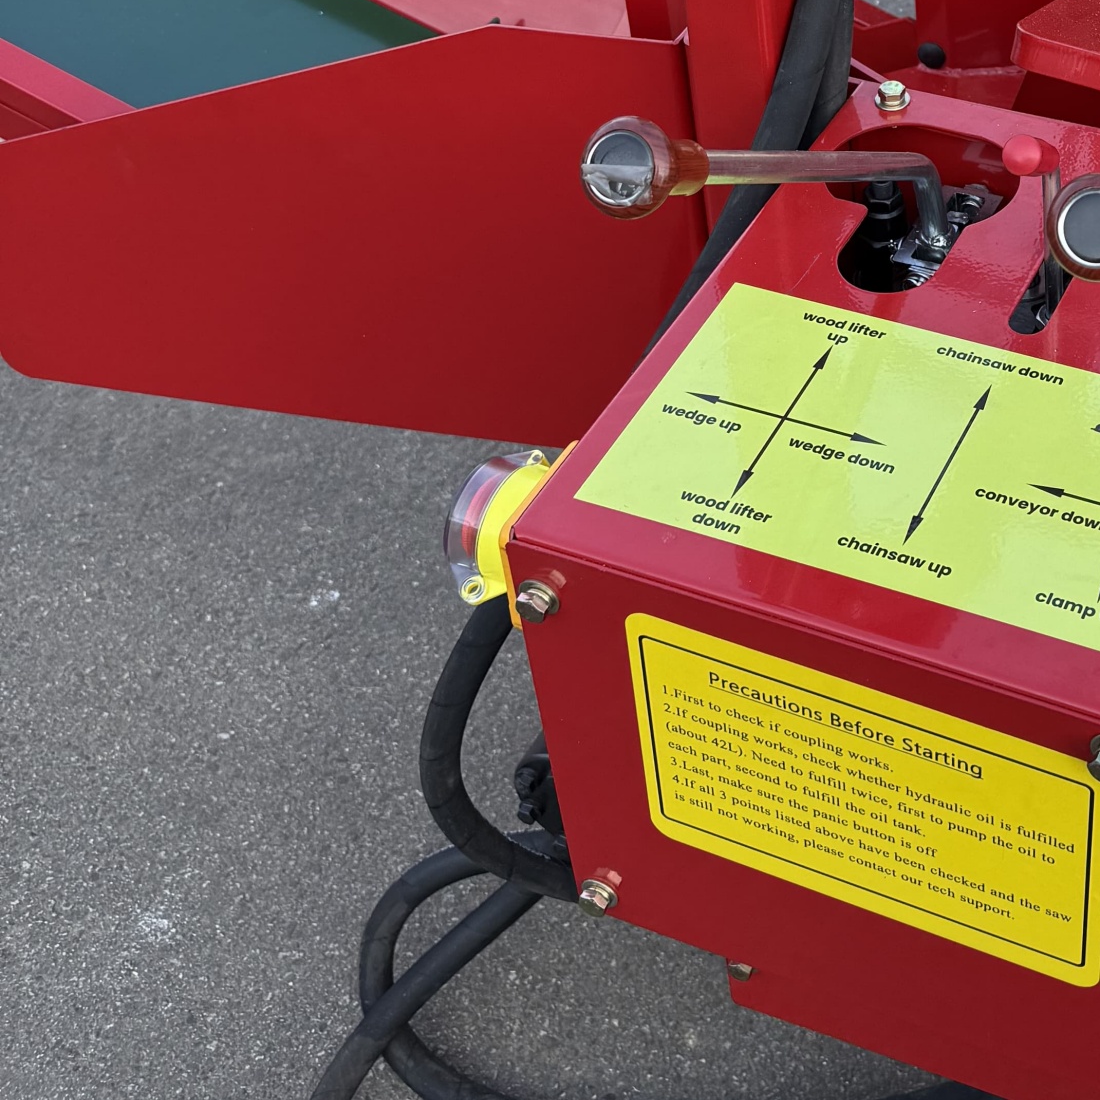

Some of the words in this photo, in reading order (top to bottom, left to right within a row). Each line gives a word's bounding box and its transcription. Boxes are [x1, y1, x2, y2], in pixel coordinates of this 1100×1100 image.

[803, 312, 848, 330] wood
[847, 322, 887, 339] lifter
[827, 332, 849, 345] up
[936, 347, 1017, 373] chainsaw
[1018, 367, 1064, 385] down
[662, 404, 717, 426] wedge
[718, 419, 742, 434] up
[788, 438, 845, 460] wedge
[847, 453, 895, 474] down
[680, 490, 730, 511] wood
[729, 502, 773, 523] lifter
[975, 488, 1059, 517] conveyor
[692, 513, 741, 535] down
[837, 536, 926, 568] chainsaw
[927, 562, 952, 579] up
[1035, 592, 1096, 620] clamp
[708, 701, 722, 713] to
[725, 708, 765, 728] check
[769, 720, 781, 733] if
[783, 728, 844, 757] coupling
[847, 750, 894, 773] works.
[709, 671, 823, 722] Precautions
[830, 712, 895, 746] Before
[902, 737, 983, 779] Starting
[663, 702, 689, 719] 2.If
[691, 714, 749, 742] coupling
[753, 735, 798, 759] works,
[802, 752, 842, 772] check
[846, 768, 901, 793] whether
[905, 785, 971, 817] hydraulic
[976, 813, 994, 826] oil
[1000, 819, 1012, 832] is
[1017, 825, 1075, 854] fulfilled
[668, 741, 697, 757] each
[701, 752, 731, 770] part,
[735, 764, 781, 786] second
[784, 780, 798, 792] to
[802, 785, 840, 807] fulfill
[845, 801, 866, 816] the
[870, 812, 888, 824] oil
[892, 818, 926, 838] tank.
[670, 756, 714, 781] 3.Last,
[718, 775, 753, 793] make
[757, 789, 784, 804] sure
[788, 798, 808, 813] the
[813, 808, 848, 827] panic
[853, 820, 896, 844] button
[900, 837, 912, 849] is
[916, 845, 938, 858] off
[675, 790, 685, 802] is
[689, 798, 713, 812] still
[717, 808, 738, 821] not
[742, 816, 799, 844] working,
[803, 838, 844, 859] please
[848, 855, 897, 878] contact
[900, 874, 923, 886] our
[927, 882, 955, 899] tech
[960, 894, 1015, 920] support.
